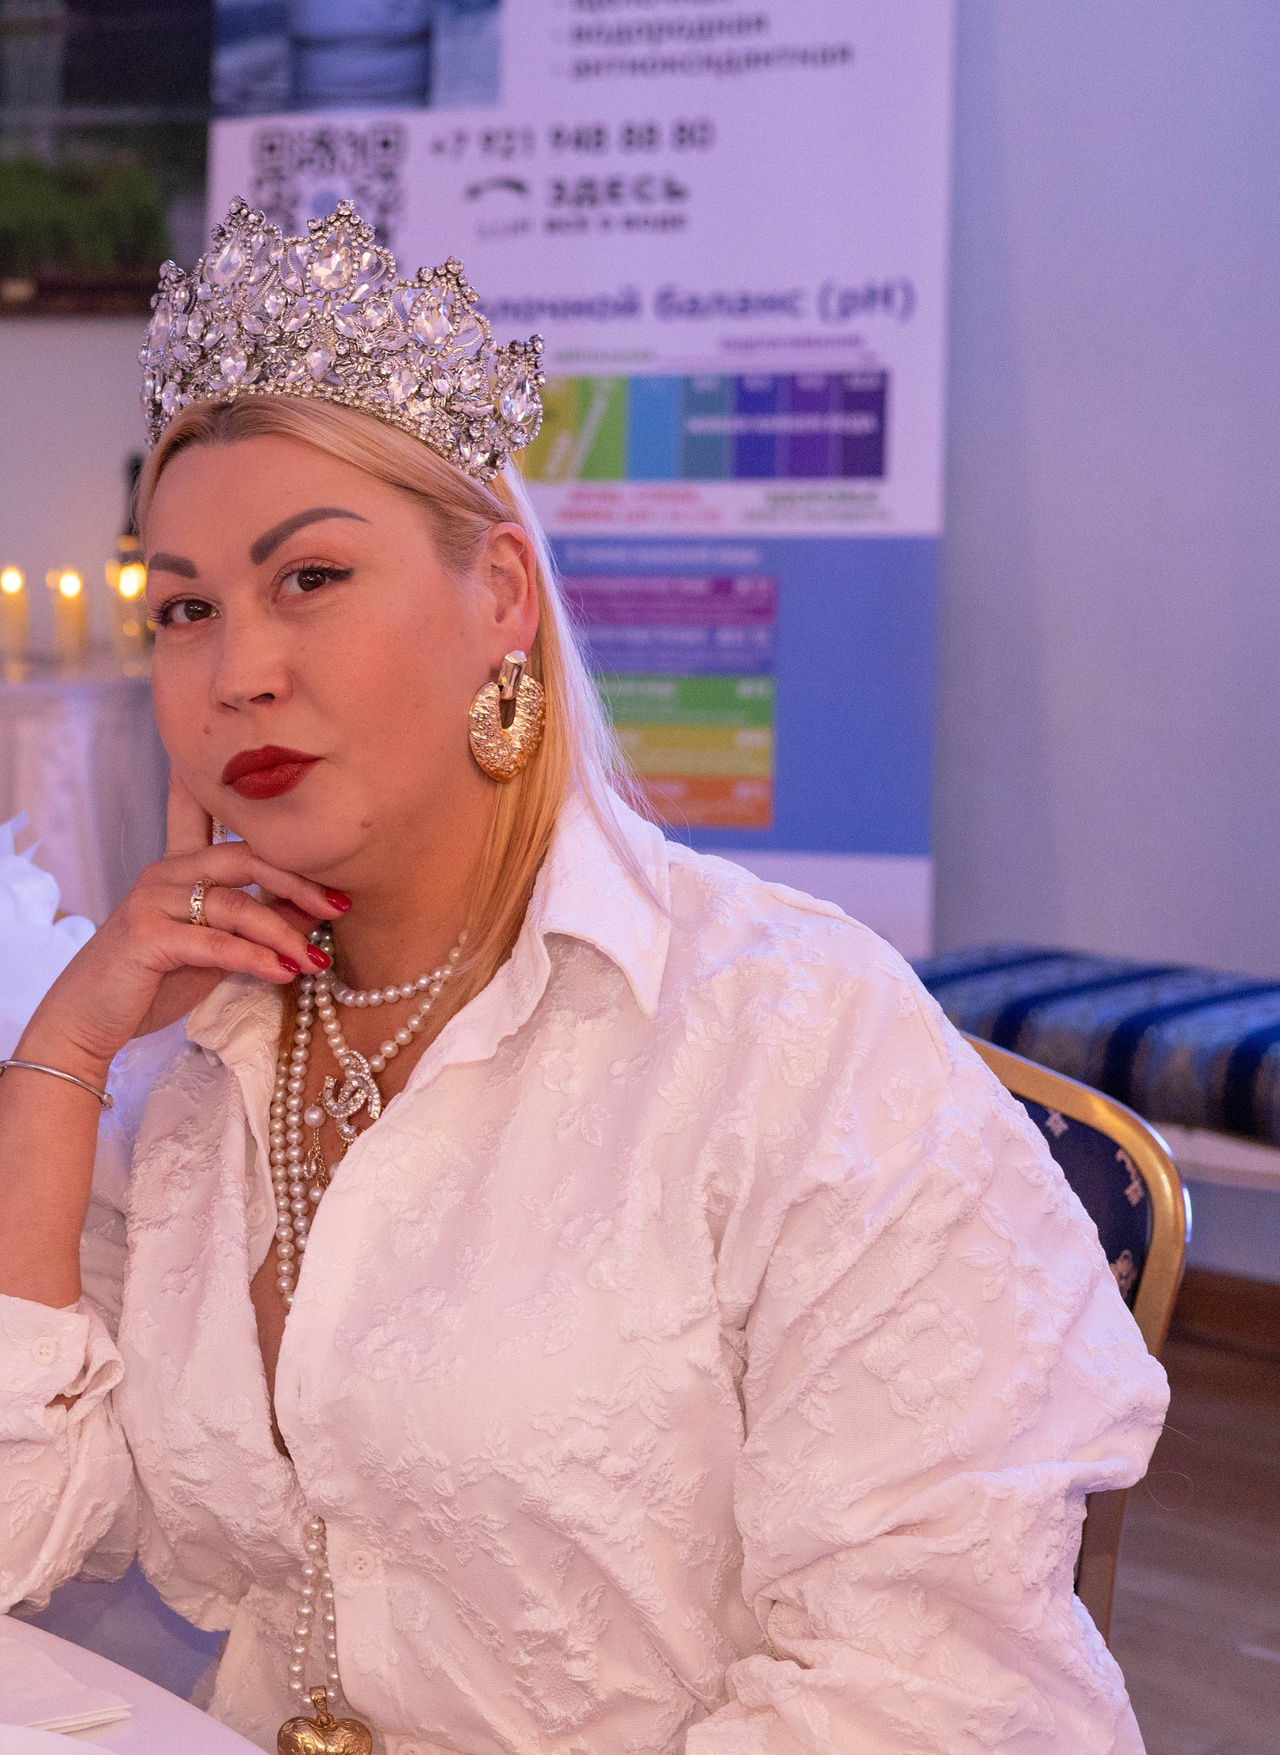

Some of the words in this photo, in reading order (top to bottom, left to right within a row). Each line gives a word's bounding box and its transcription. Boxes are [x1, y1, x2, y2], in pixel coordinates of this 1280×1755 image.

[546, 174, 690, 209] ЗДЕСЬ
[477, 283, 641, 323] лочной
[655, 284, 807, 320] баланс
